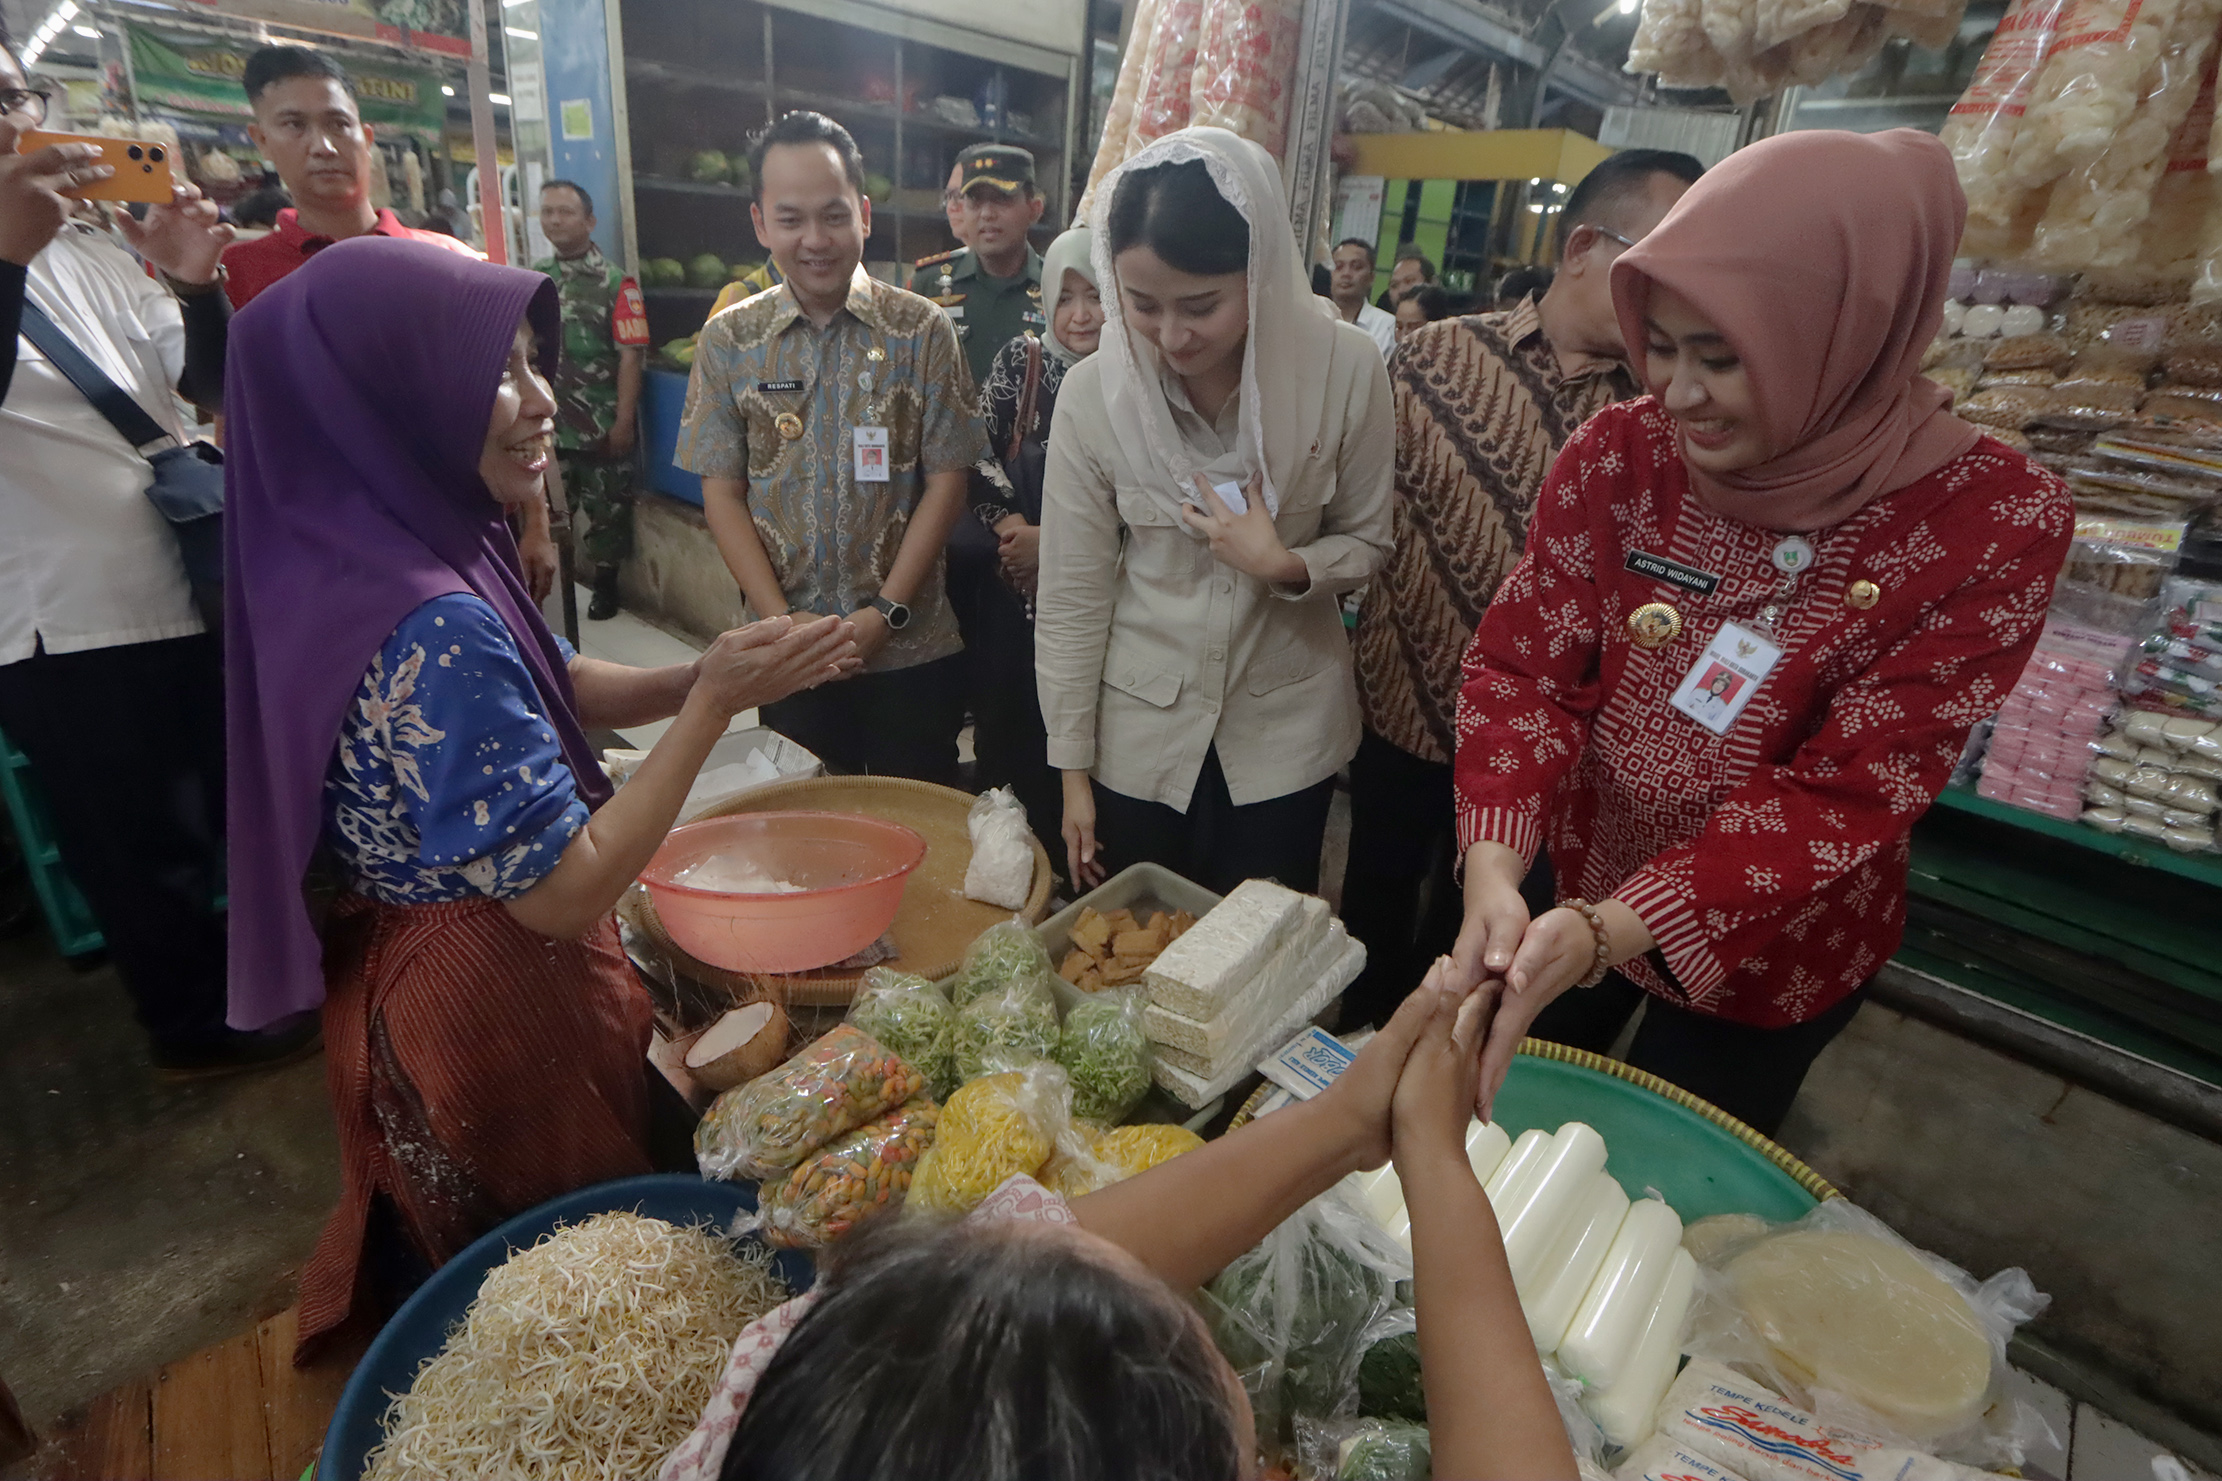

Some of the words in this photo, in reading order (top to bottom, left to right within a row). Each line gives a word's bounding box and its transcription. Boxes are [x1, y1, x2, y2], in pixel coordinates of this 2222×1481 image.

[1306, 81, 1320, 131] FILMA
[1299, 142, 1313, 190] FILMA
[1634, 558, 1666, 575] ASTRID
[1667, 568, 1709, 589] WIDAYANI
[1710, 1384, 1754, 1405] TEMPE
[1754, 1402, 1809, 1426] KEDELE
[1674, 1451, 1719, 1477] TEMPE
[1683, 1418, 1712, 1433] tempe
[1713, 1431, 1745, 1448] paling
[1748, 1444, 1779, 1462] bersih
[1782, 1459, 1803, 1471] dan
